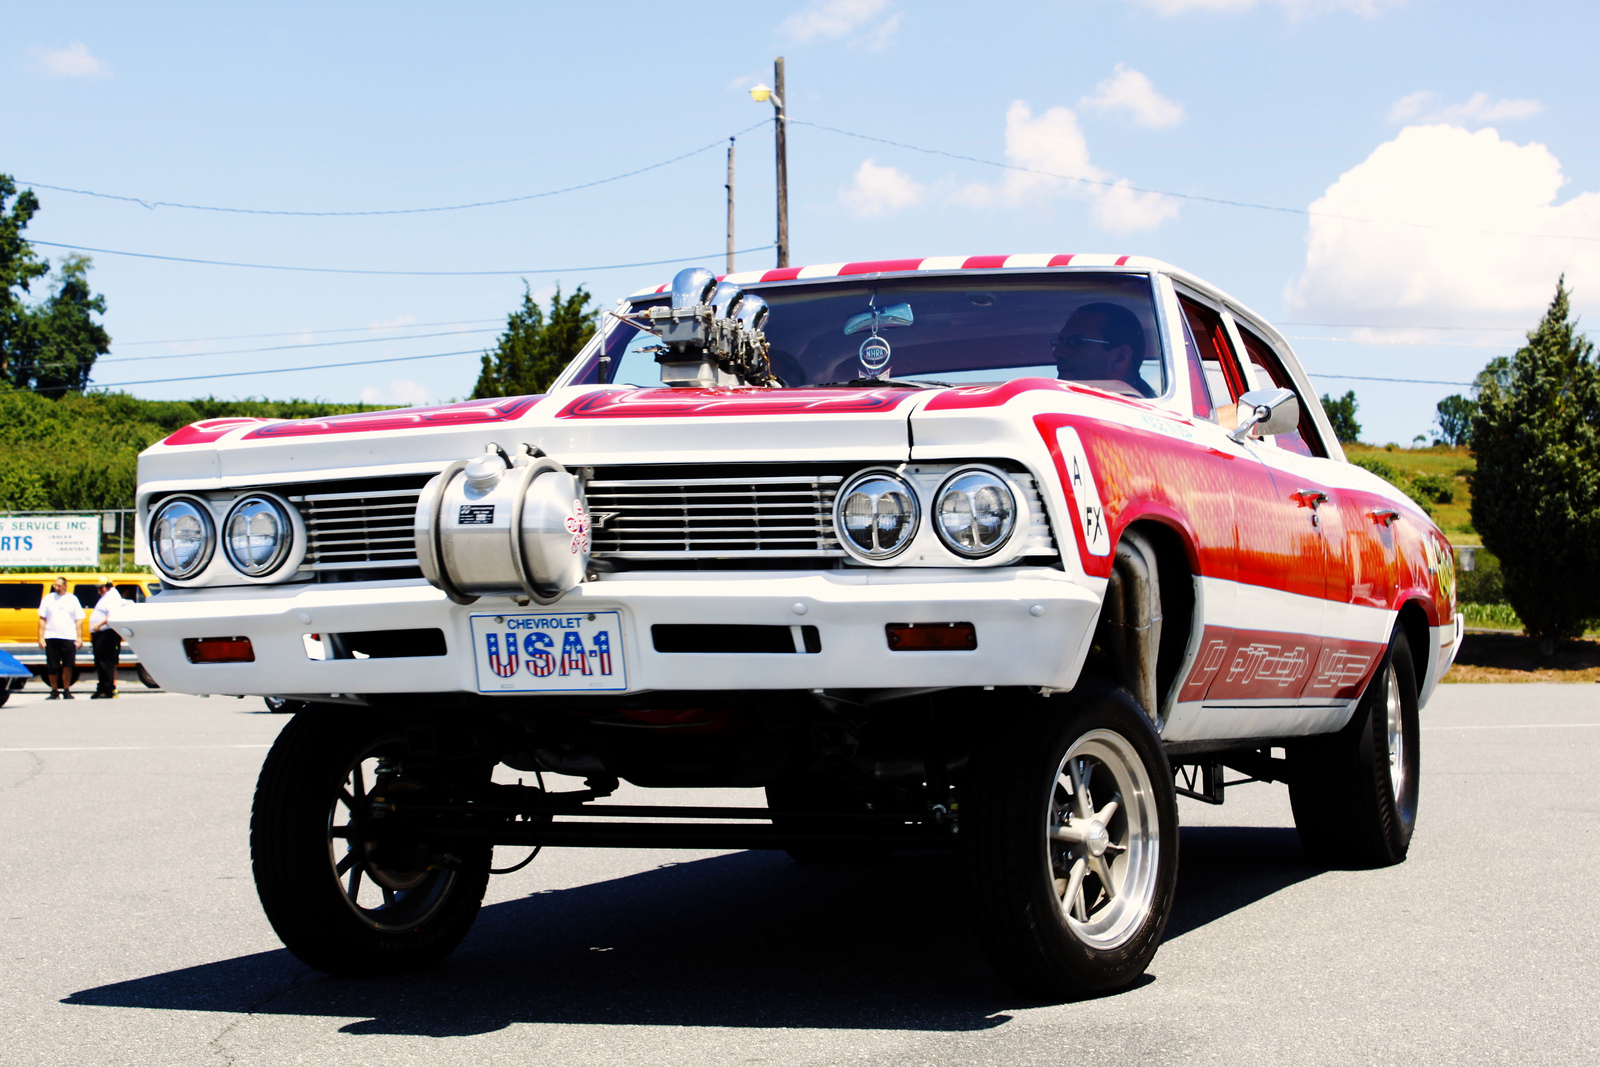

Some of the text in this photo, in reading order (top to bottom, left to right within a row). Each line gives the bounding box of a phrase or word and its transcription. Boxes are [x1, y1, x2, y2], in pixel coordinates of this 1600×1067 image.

[866, 348, 884, 357] NHRA
[1073, 455, 1082, 486] A
[11, 521, 61, 531] SERVICE
[67, 521, 91, 530] INC.
[1086, 506, 1103, 544] FX
[1, 535, 33, 551] RTS
[507, 617, 582, 630] CHEVROLET
[485, 631, 613, 678] USA-1
